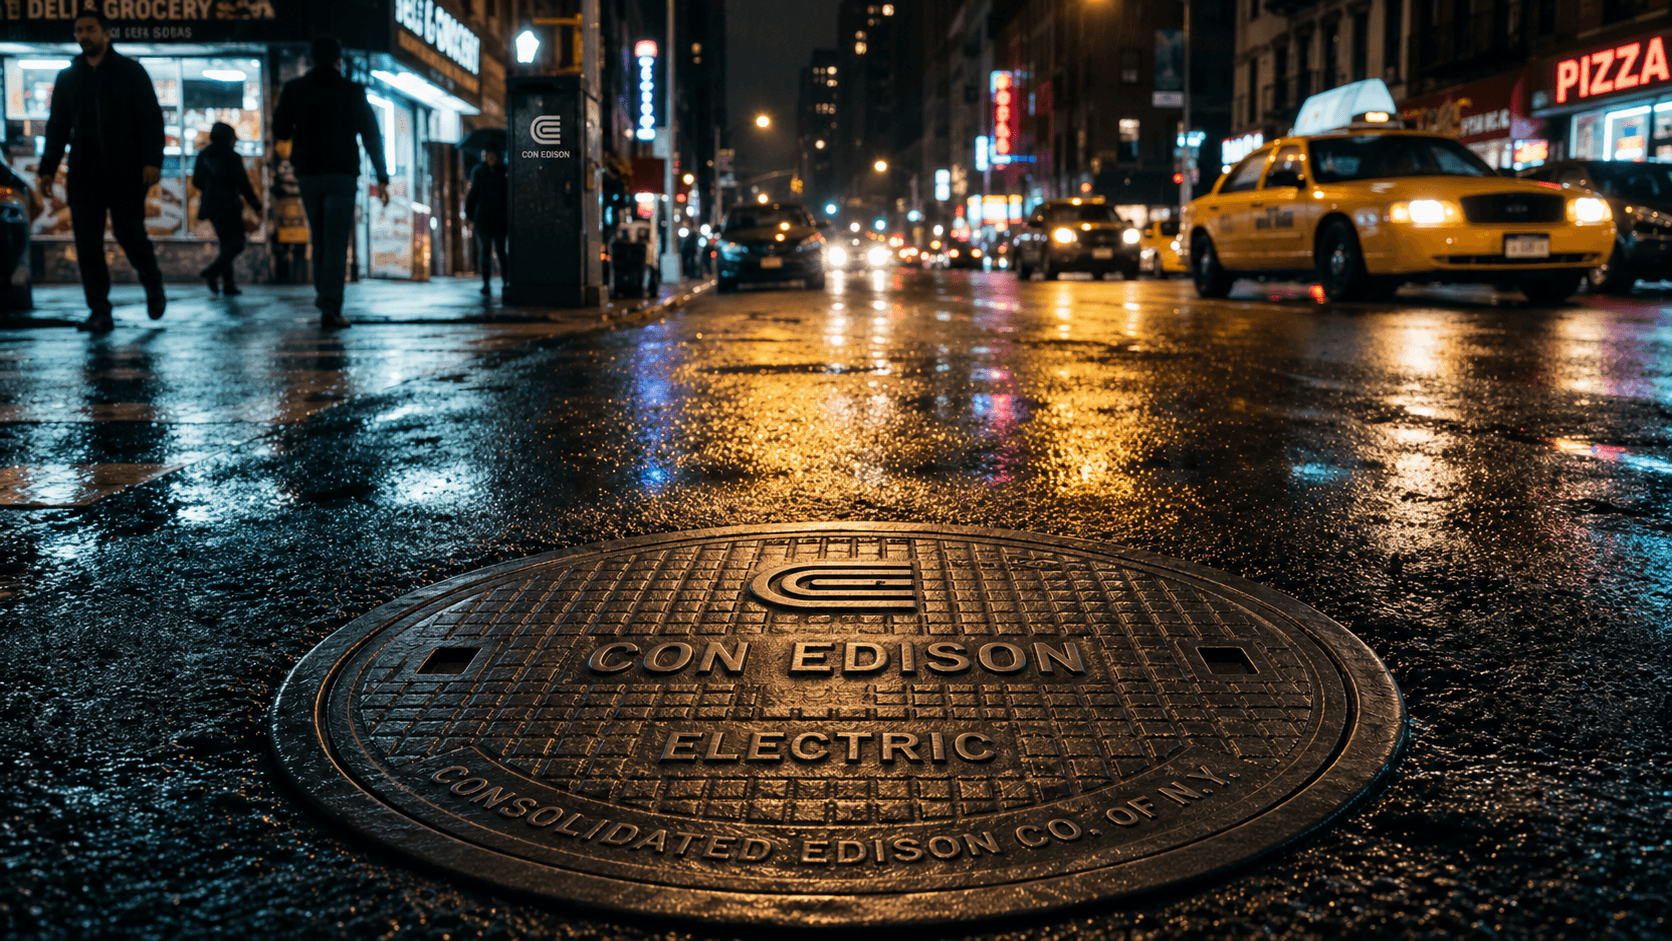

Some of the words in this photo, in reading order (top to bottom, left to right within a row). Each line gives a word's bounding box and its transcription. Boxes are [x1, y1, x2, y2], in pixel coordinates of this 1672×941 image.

[28, 0, 78, 20] DELI
[103, 0, 211, 20] GROCERY
[1556, 36, 1671, 104] PIZZA
[521, 150, 539, 159] CON
[540, 150, 570, 159] EDISON
[587, 641, 751, 675] CON
[788, 641, 1087, 675] EDISON
[658, 731, 998, 764] ELECTRIC
[431, 765, 773, 864] CONSOLIDATED
[802, 830, 1001, 864] EDISON
[1014, 818, 1102, 849] CO.
[1106, 796, 1158, 827] OF
